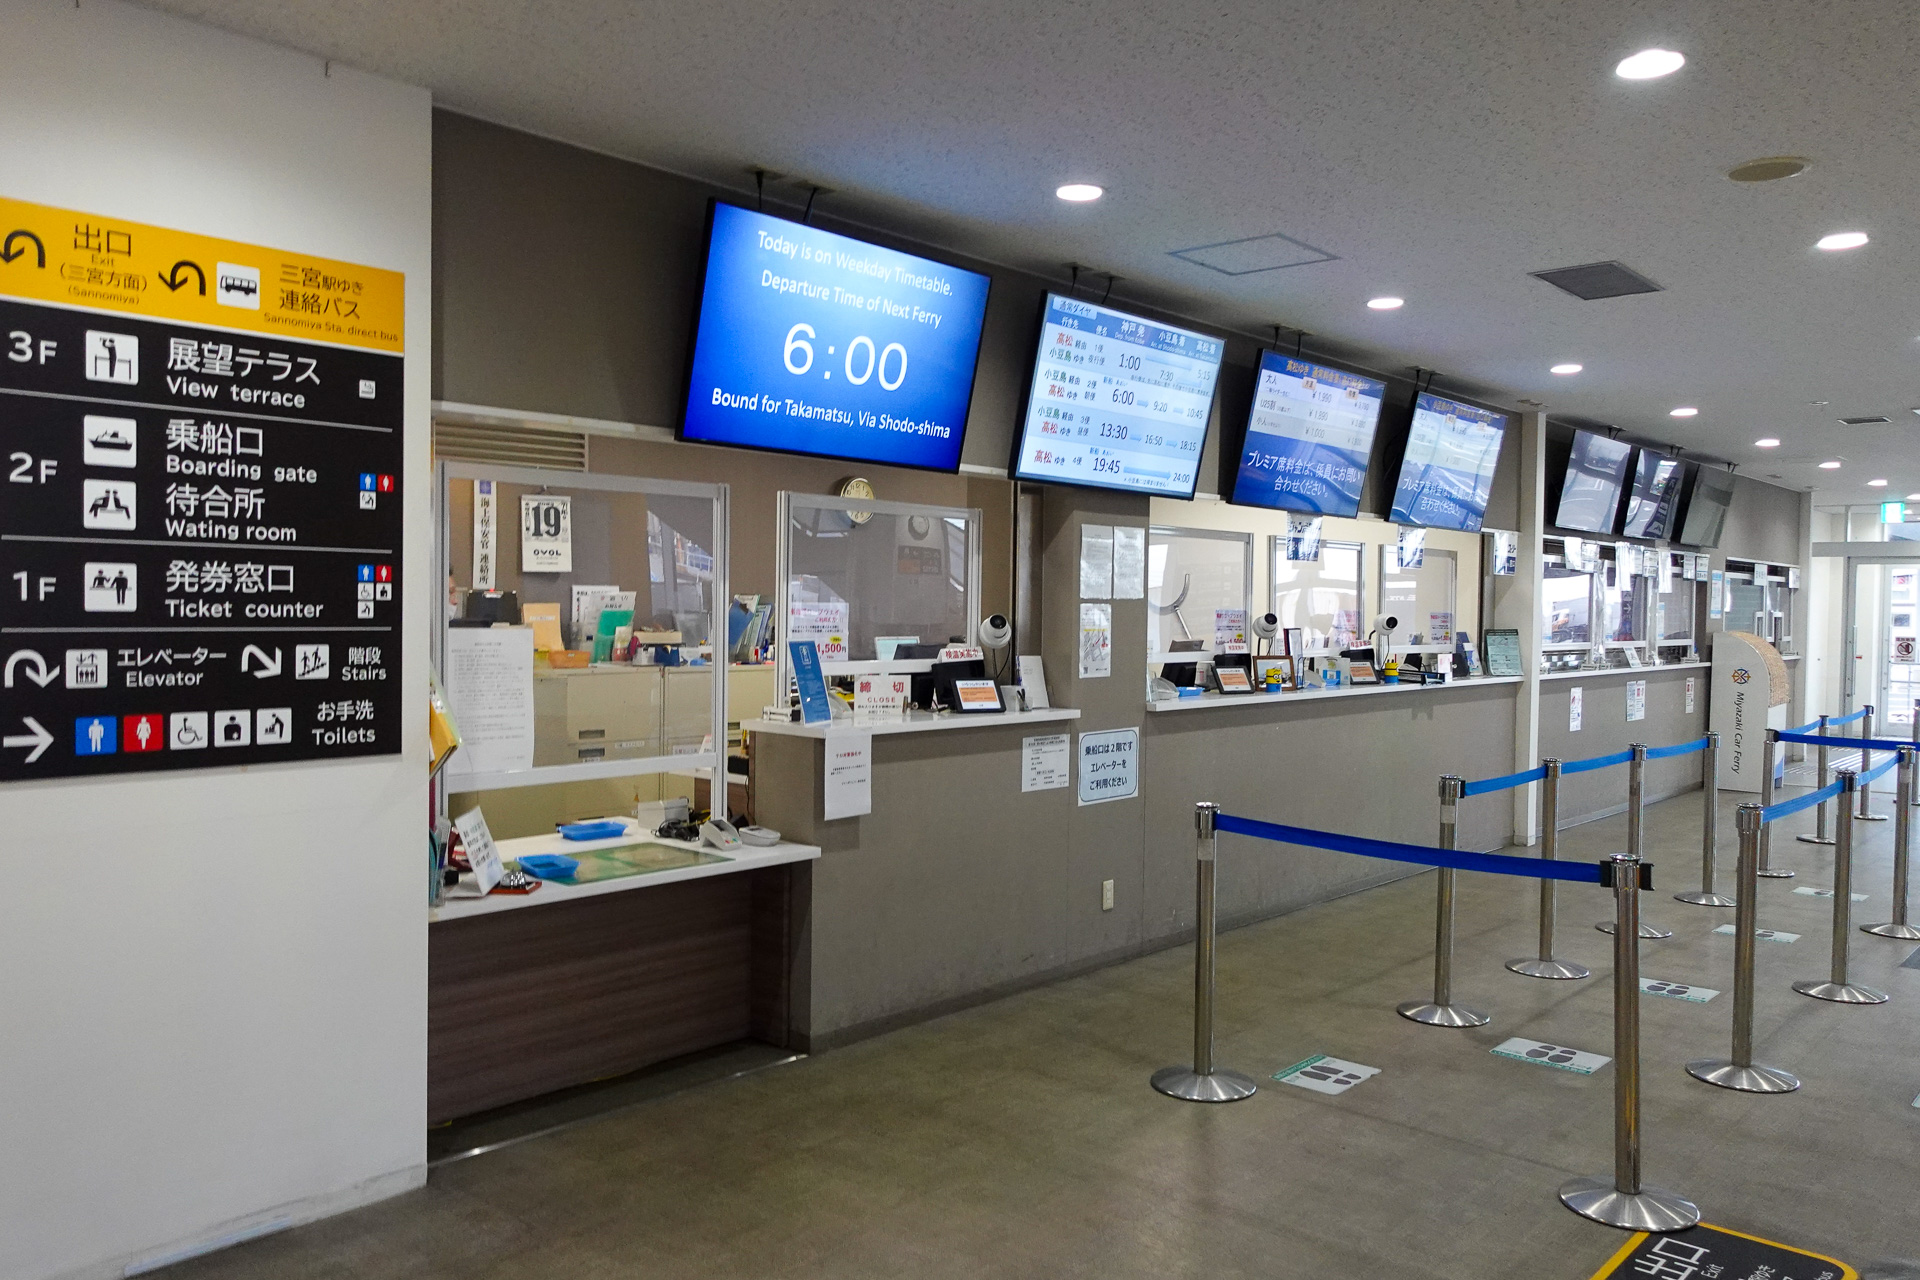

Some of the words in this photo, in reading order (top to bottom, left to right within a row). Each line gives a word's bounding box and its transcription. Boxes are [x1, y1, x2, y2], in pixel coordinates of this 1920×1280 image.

[73, 222, 132, 257] 出口
[91, 254, 115, 267] Exit
[757, 230, 799, 259] Today
[801, 242, 812, 261] is
[815, 249, 832, 266] on
[835, 252, 892, 285] Weekday
[279, 262, 365, 297] 三宮駅ゆき
[68, 285, 140, 306] (Sannomiya)
[278, 288, 361, 320] 連絡バス
[761, 269, 831, 302] Departure
[833, 286, 864, 310] Time
[866, 293, 882, 312] of
[882, 299, 910, 320] Next
[912, 305, 943, 330] Ferry
[263, 311, 322, 331] Sannomiya
[324, 321, 345, 333] Sta.
[347, 324, 378, 340] direct
[379, 330, 399, 343] bus
[7, 330, 58, 365] 3F
[1056, 331, 1073, 347] 高松
[166, 336, 321, 386] 展望テラス
[782, 322, 908, 392] 6:00
[1049, 348, 1072, 363] 小豆島
[1073, 354, 1085, 365] ゆき
[1118, 353, 1141, 371] 1:00
[1044, 368, 1067, 384] 小豆島
[1159, 369, 1174, 382] 7:30
[1266, 373, 1278, 386] 大人
[166, 376, 218, 399] View
[230, 385, 306, 409] terrace
[1047, 384, 1065, 398] 高松
[1066, 390, 1078, 401] ゆき
[1112, 388, 1135, 406] 6:00
[711, 387, 759, 412] Bound
[761, 394, 782, 415] for
[784, 399, 855, 428] Takamatsu,
[858, 410, 876, 429] Via
[878, 413, 951, 440] Shodo-shima
[1037, 405, 1061, 420] 小豆島
[1153, 400, 1168, 413] 9:20
[1186, 407, 1204, 420] 10:45
[165, 418, 264, 457] 乗船口
[1041, 421, 1059, 435] 高松
[1059, 427, 1071, 437] ゆき
[1099, 422, 1128, 440] 13:30
[1144, 434, 1163, 447] 16:50
[1179, 440, 1197, 452] 18:15
[1033, 449, 1053, 464] 高松
[1054, 455, 1066, 466] ゆき
[1092, 457, 1121, 474] 19:45
[8, 452, 58, 484] 2F
[166, 455, 262, 480] Boarding
[273, 467, 318, 484] gate
[1247, 450, 1361, 484] プレミア席料金は、係員にお問い
[1172, 472, 1190, 484] 24:00
[1274, 475, 1329, 498] 合わせください。
[165, 483, 265, 520] 待合所
[165, 518, 239, 541] Wating
[246, 526, 297, 542] room
[531, 506, 561, 537] 19
[165, 559, 295, 594] 発券窓口
[12, 570, 57, 602] 1F
[165, 598, 233, 618] Ticket
[245, 601, 324, 619] counter
[117, 647, 228, 665] エレベーター
[347, 646, 382, 665] 階段
[126, 671, 204, 688] Elevator
[341, 665, 387, 682] Stairs
[316, 699, 375, 722] お手洗
[1734, 691, 1744, 731] Miyazaki
[312, 728, 376, 746] Toilets
[1734, 733, 1743, 748] Car
[1090, 758, 1127, 773] エレベーターを
[1731, 750, 1742, 775] Ferry
[1089, 776, 1128, 791] ご利用ください
[1700, 1263, 1725, 1279] Exit
